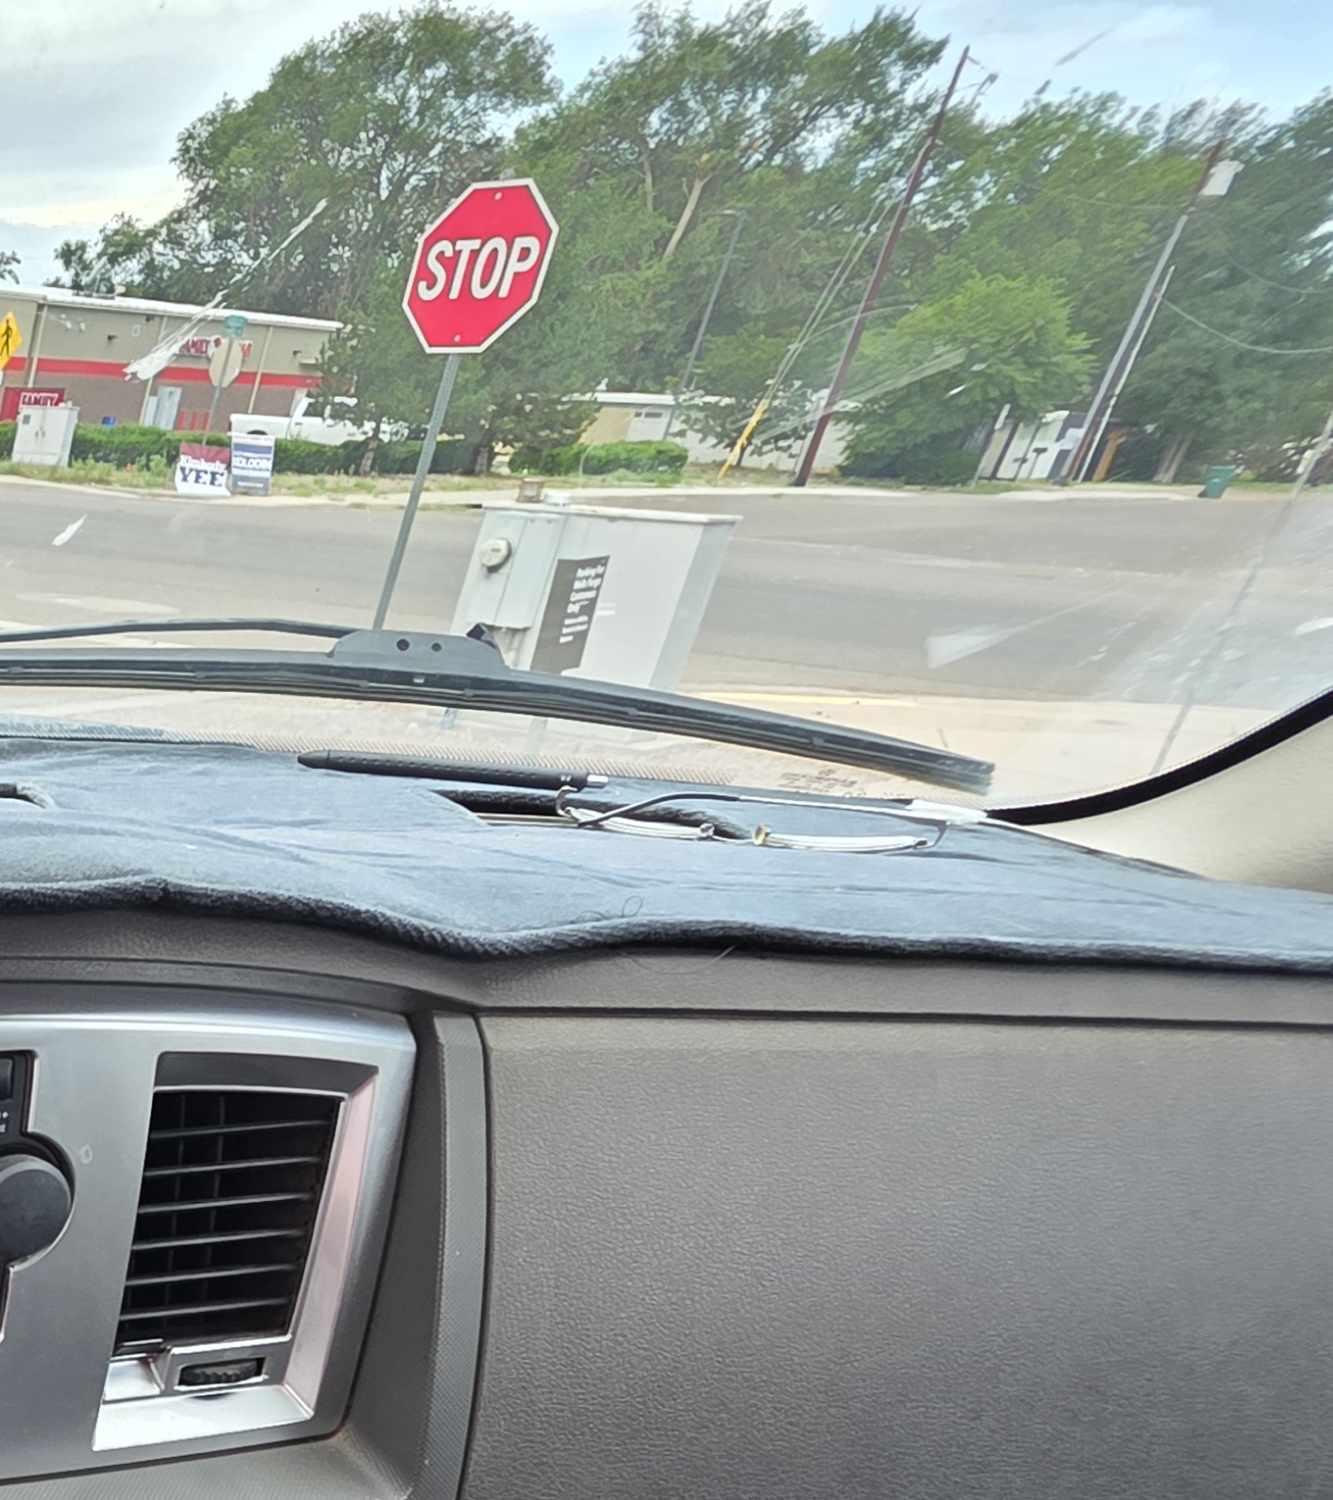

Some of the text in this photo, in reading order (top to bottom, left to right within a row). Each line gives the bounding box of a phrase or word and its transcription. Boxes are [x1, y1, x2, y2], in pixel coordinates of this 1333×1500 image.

[417, 236, 541, 301] STOP
[20, 392, 58, 407] FAMILY
[179, 466, 225, 487] YEE
